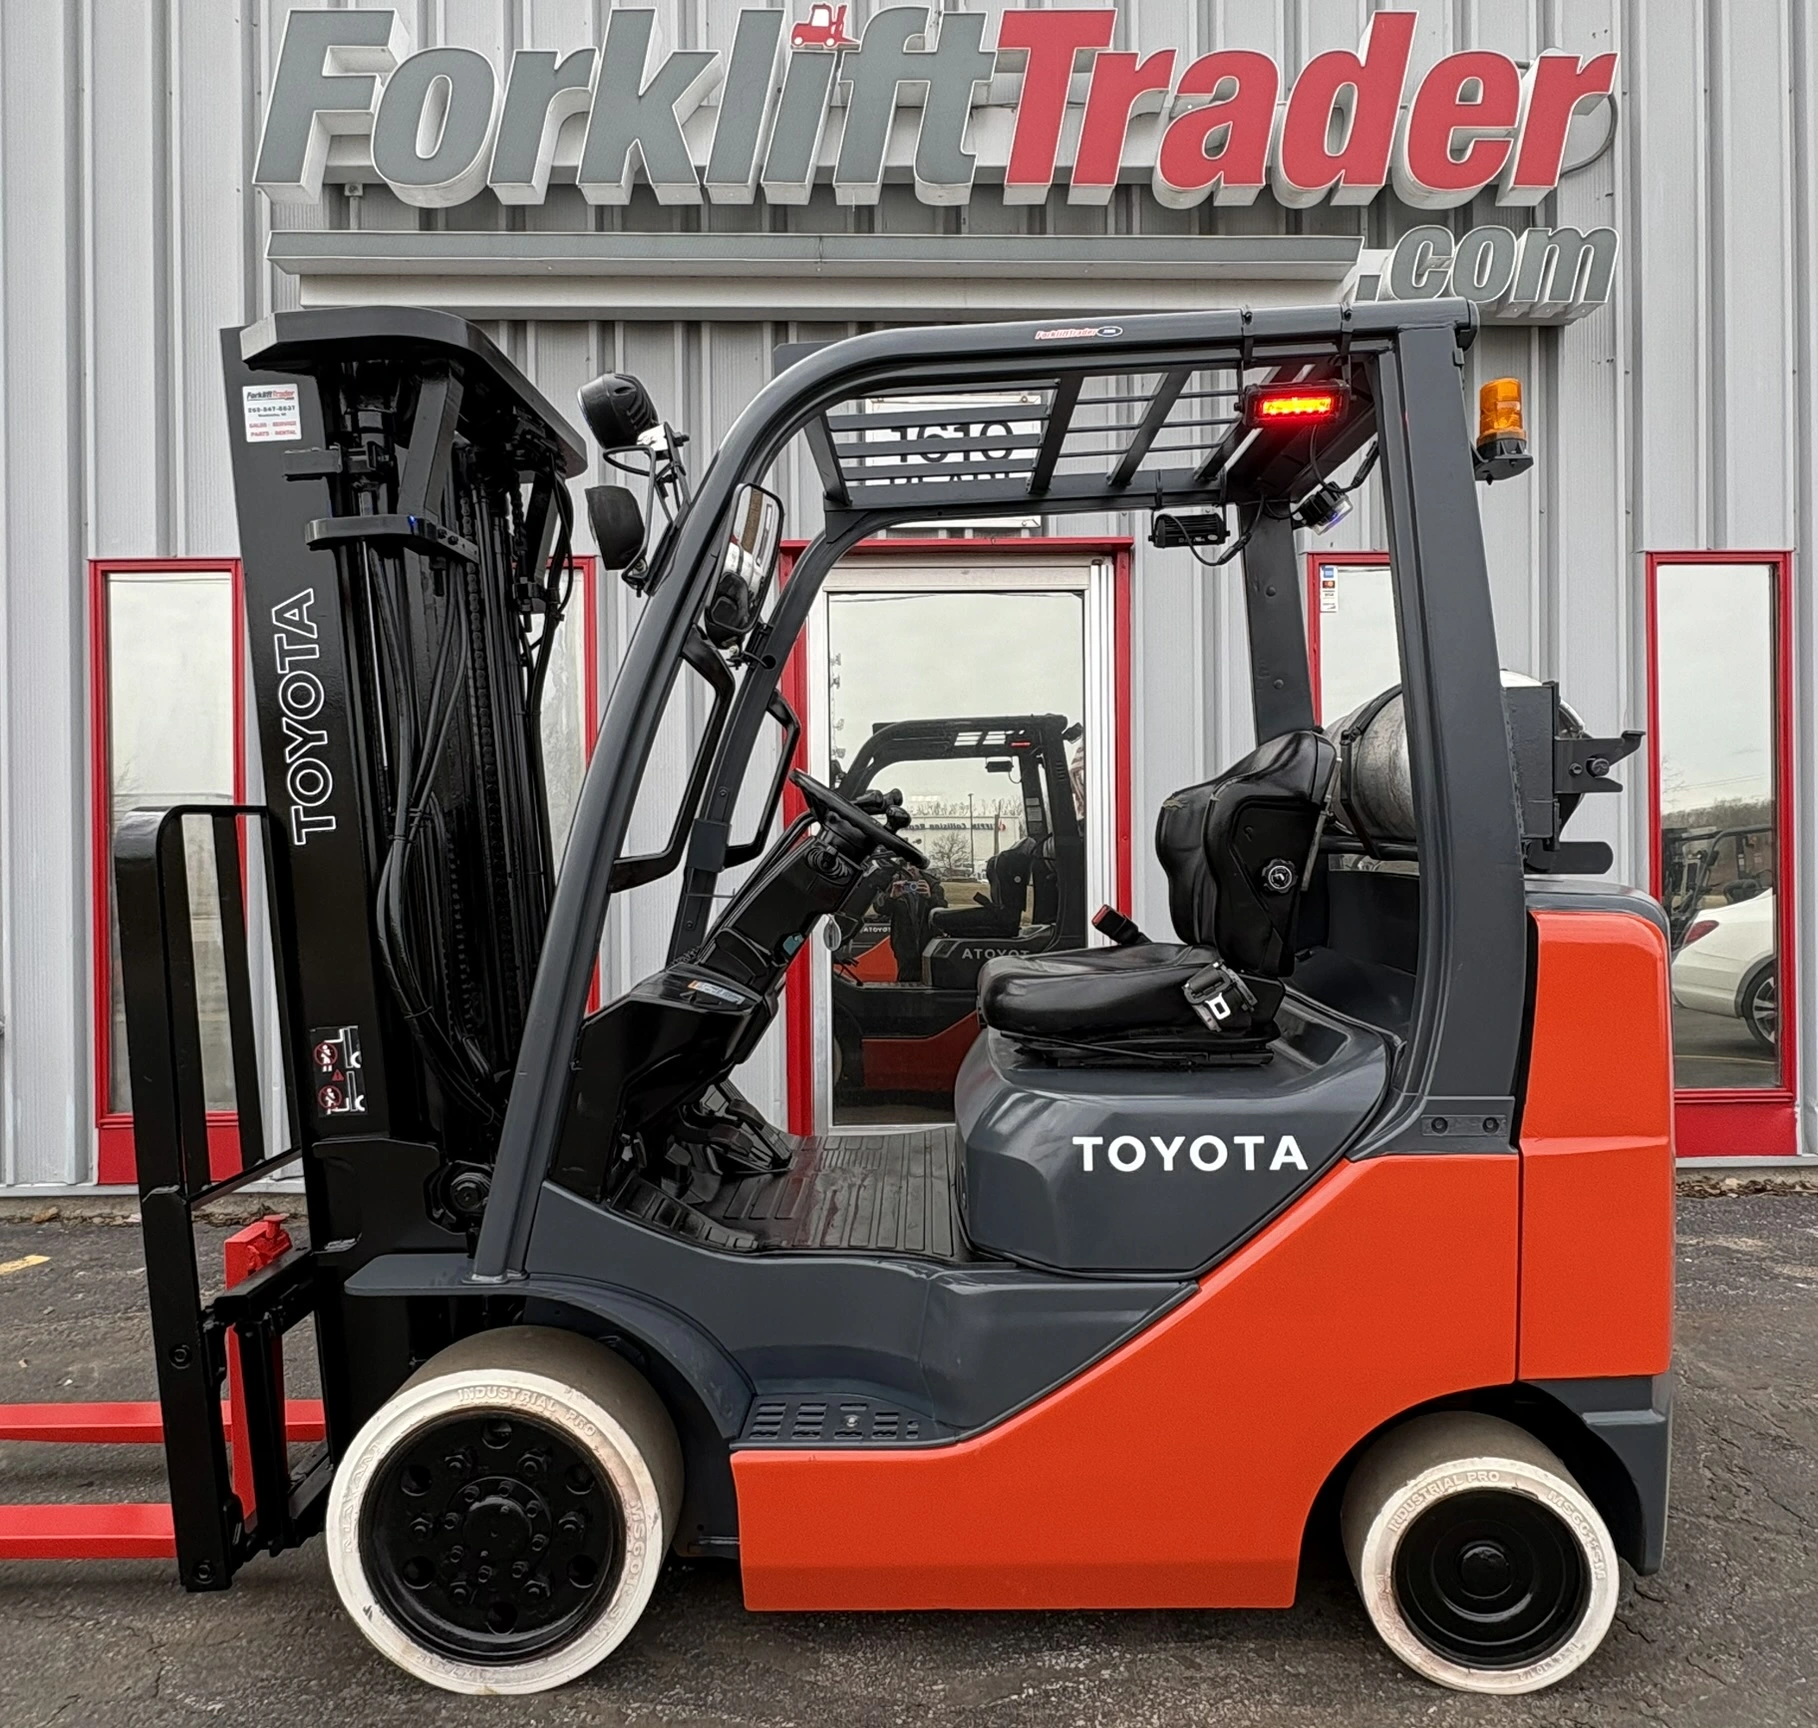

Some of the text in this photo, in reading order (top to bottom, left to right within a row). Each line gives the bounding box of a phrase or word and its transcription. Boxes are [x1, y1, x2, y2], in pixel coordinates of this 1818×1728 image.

[253, 5, 1618, 196] ForkliftTrader
[1354, 224, 1620, 305] .com
[890, 421, 1014, 463] 1610
[272, 588, 336, 845] TOYOTA
[1072, 1134, 1309, 1172] TOYOTA
[457, 1386, 597, 1438] INDUSTRIAL PRO
[1387, 1471, 1500, 1533] INDUSTRIAL PRO
